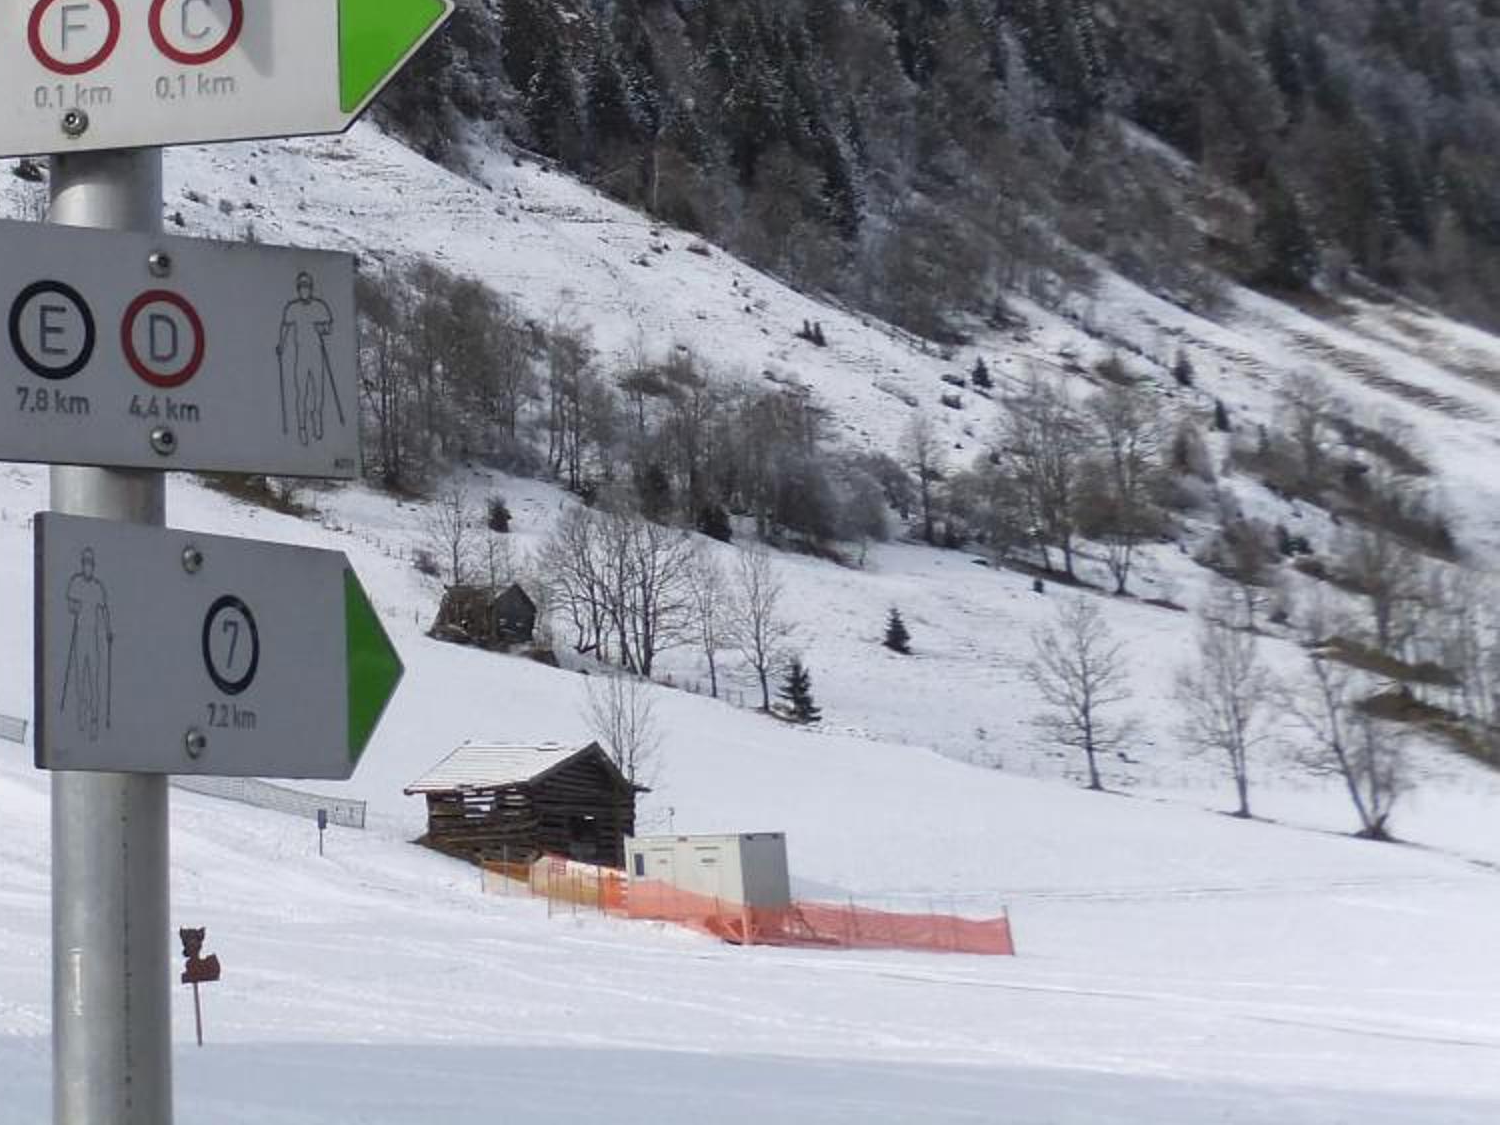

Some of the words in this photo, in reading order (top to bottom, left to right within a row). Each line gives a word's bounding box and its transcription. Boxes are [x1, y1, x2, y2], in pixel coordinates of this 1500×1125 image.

[61, 4, 90, 52] F
[74, 80, 112, 106] km
[197, 73, 235, 95] km
[39, 305, 67, 355] E
[149, 313, 178, 362] D
[54, 390, 90, 415] km
[164, 397, 200, 421] km
[222, 619, 239, 669] 7
[232, 703, 257, 730] km
